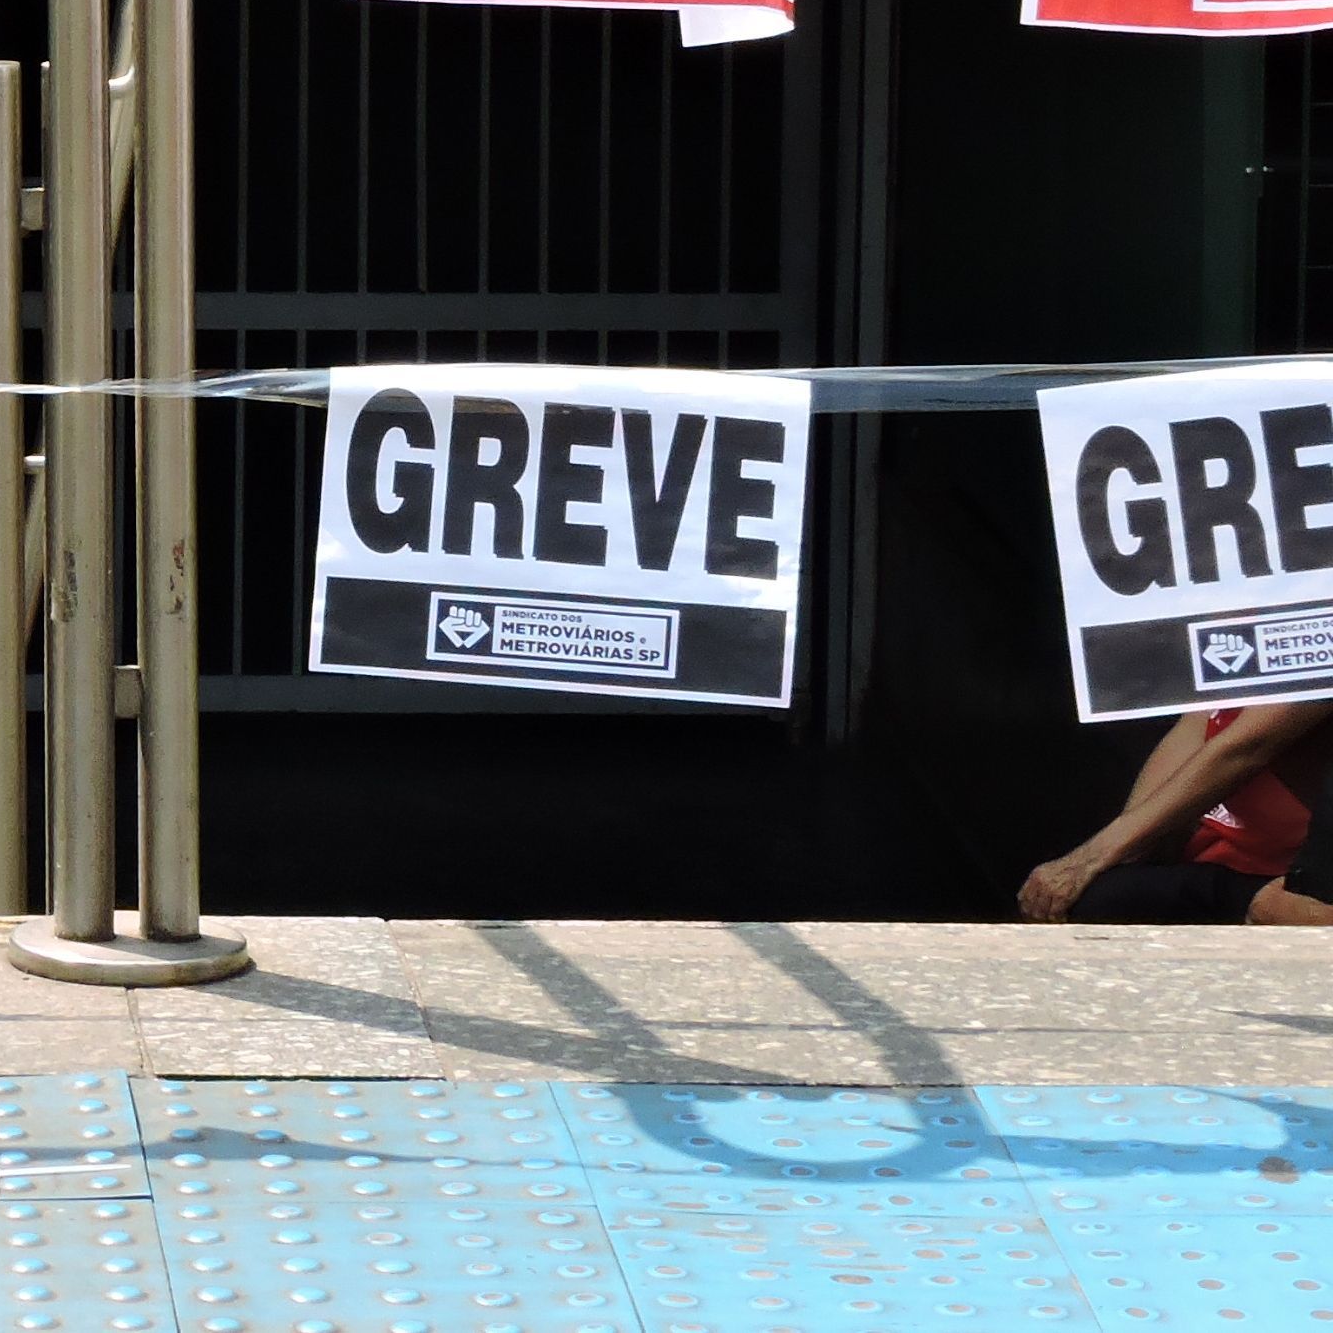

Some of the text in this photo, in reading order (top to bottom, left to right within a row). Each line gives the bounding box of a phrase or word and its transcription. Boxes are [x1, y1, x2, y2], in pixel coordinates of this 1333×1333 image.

[346, 387, 786, 581] GREVE
[1075, 403, 1333, 597] GRE
[502, 610, 582, 623] SINDICATO DOS
[501, 622, 635, 643] METROVIÁRIOS
[500, 639, 660, 661] METROVIÁRIAS SP
